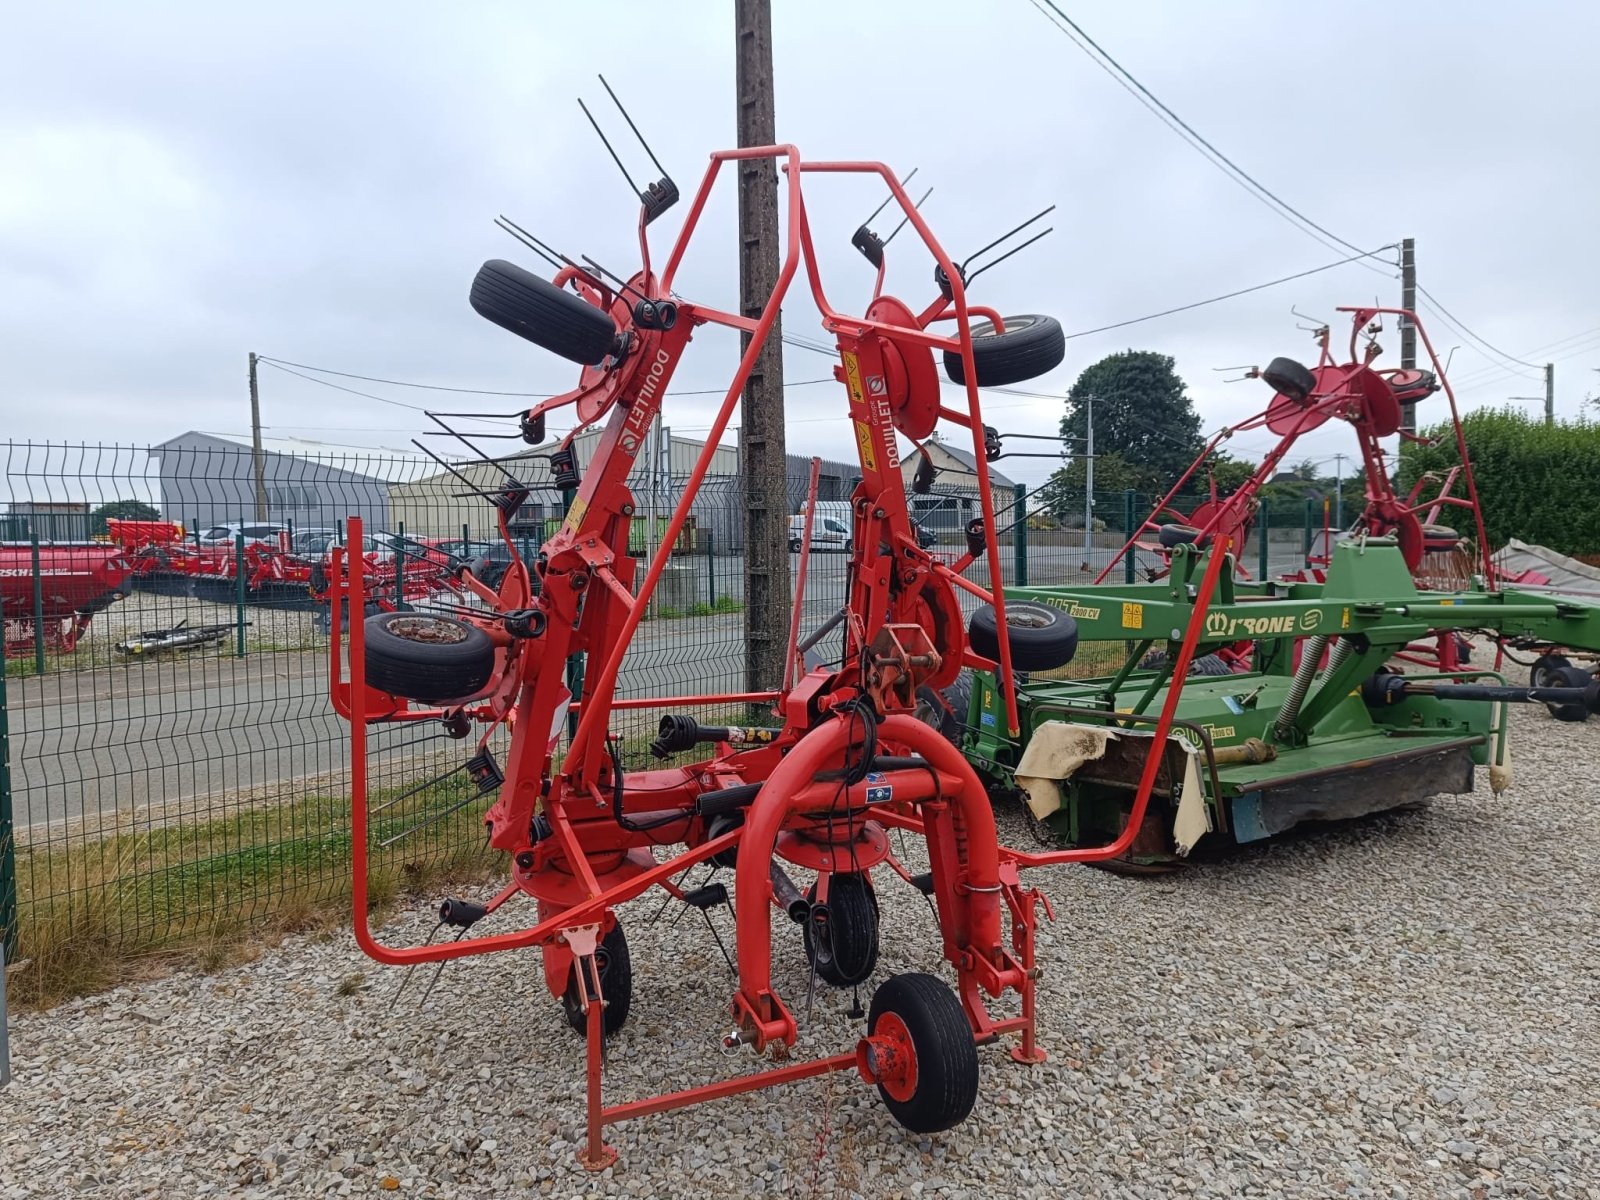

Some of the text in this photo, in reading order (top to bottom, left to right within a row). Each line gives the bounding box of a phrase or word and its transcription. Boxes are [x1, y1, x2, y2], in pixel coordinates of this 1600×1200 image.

[629, 349, 670, 429] DOUILLET
[870, 400, 879, 426] Groupe
[877, 400, 900, 469] DOUILLET
[1227, 616, 1296, 636] KRONE
